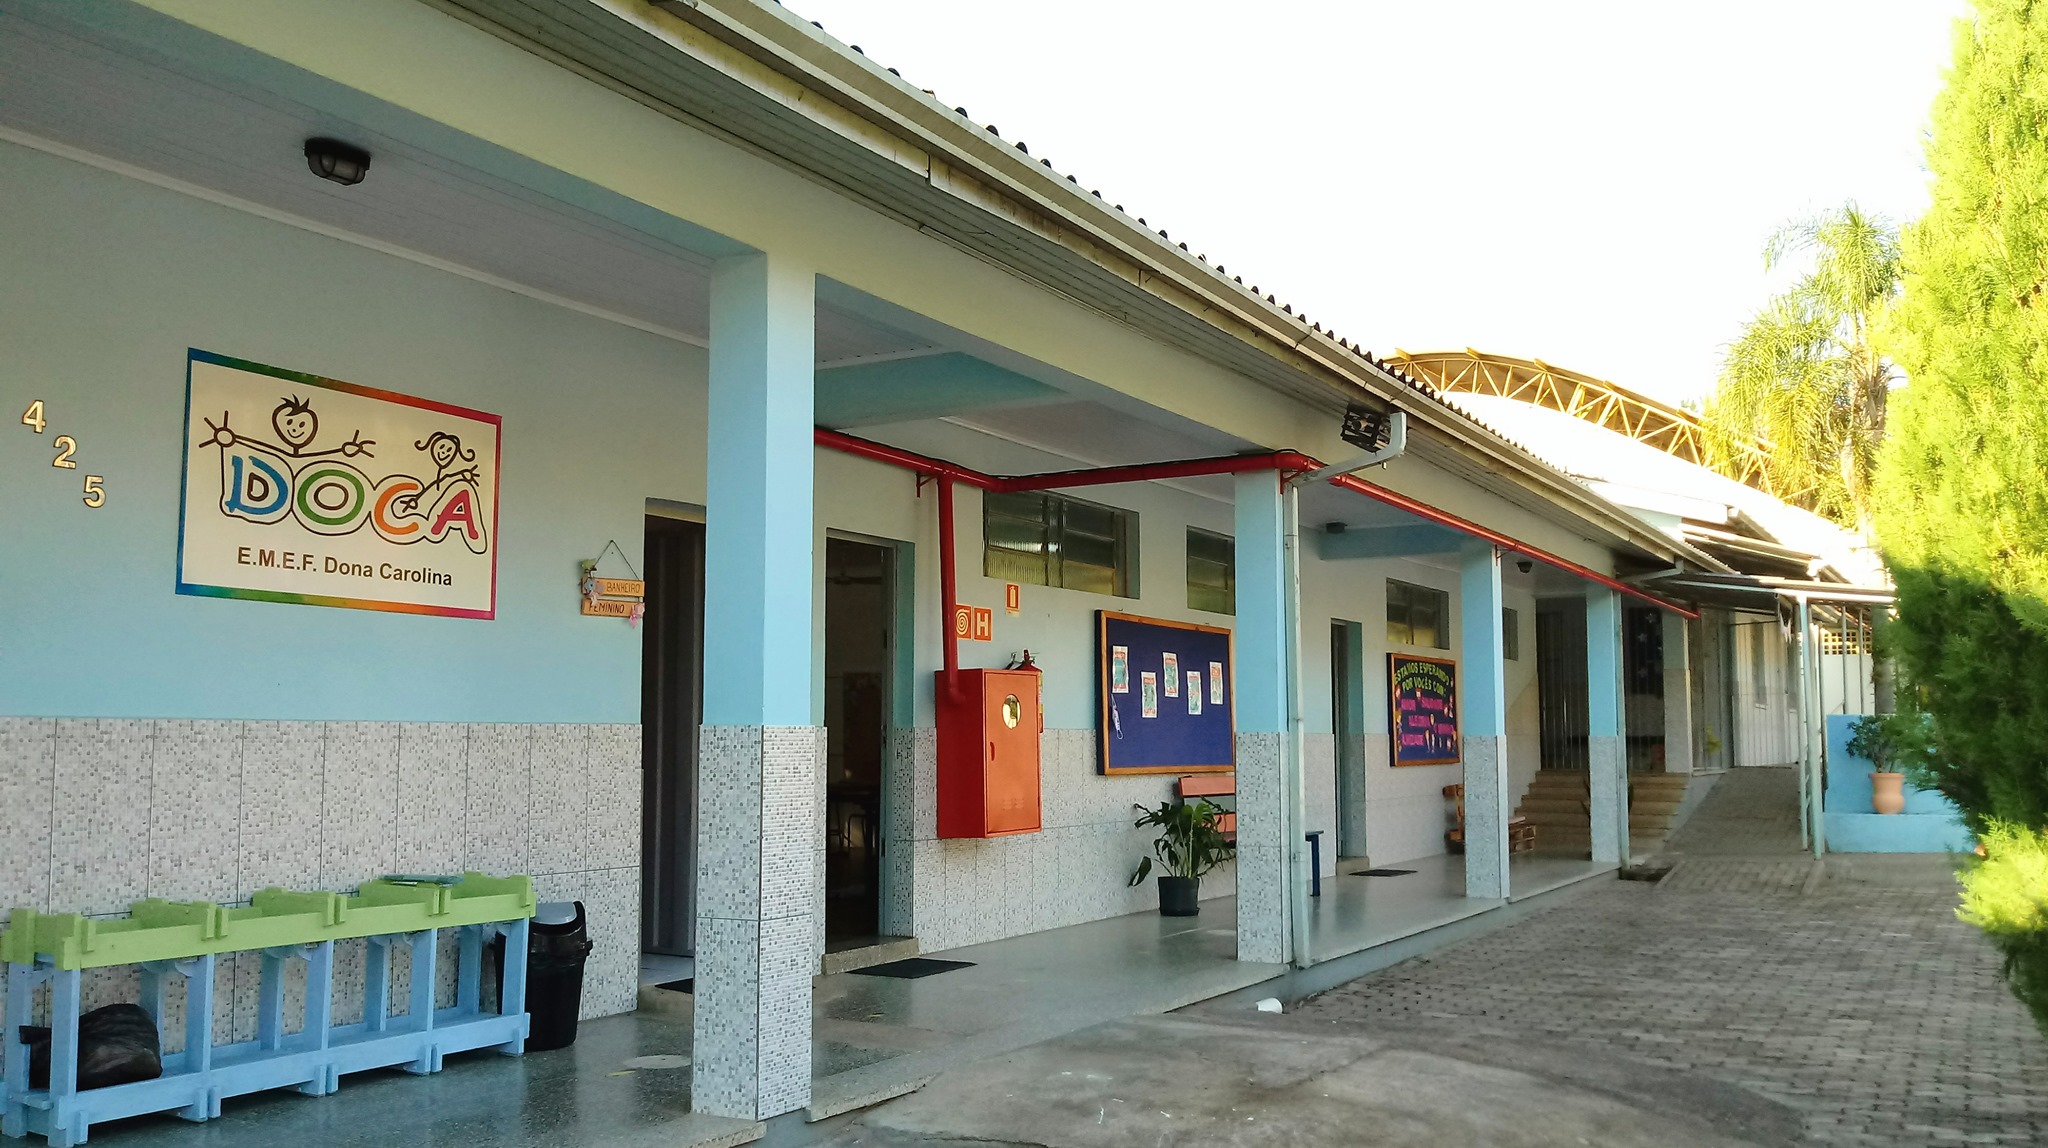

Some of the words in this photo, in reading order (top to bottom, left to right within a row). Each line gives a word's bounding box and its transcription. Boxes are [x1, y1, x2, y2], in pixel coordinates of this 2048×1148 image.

[225, 454, 480, 540] DOCA
[237, 546, 317, 572] E.M.E.F.
[324, 556, 373, 578] Dona
[379, 562, 452, 586] Carolina
[606, 581, 640, 593] BANHEIRO
[976, 612, 989, 637] H
